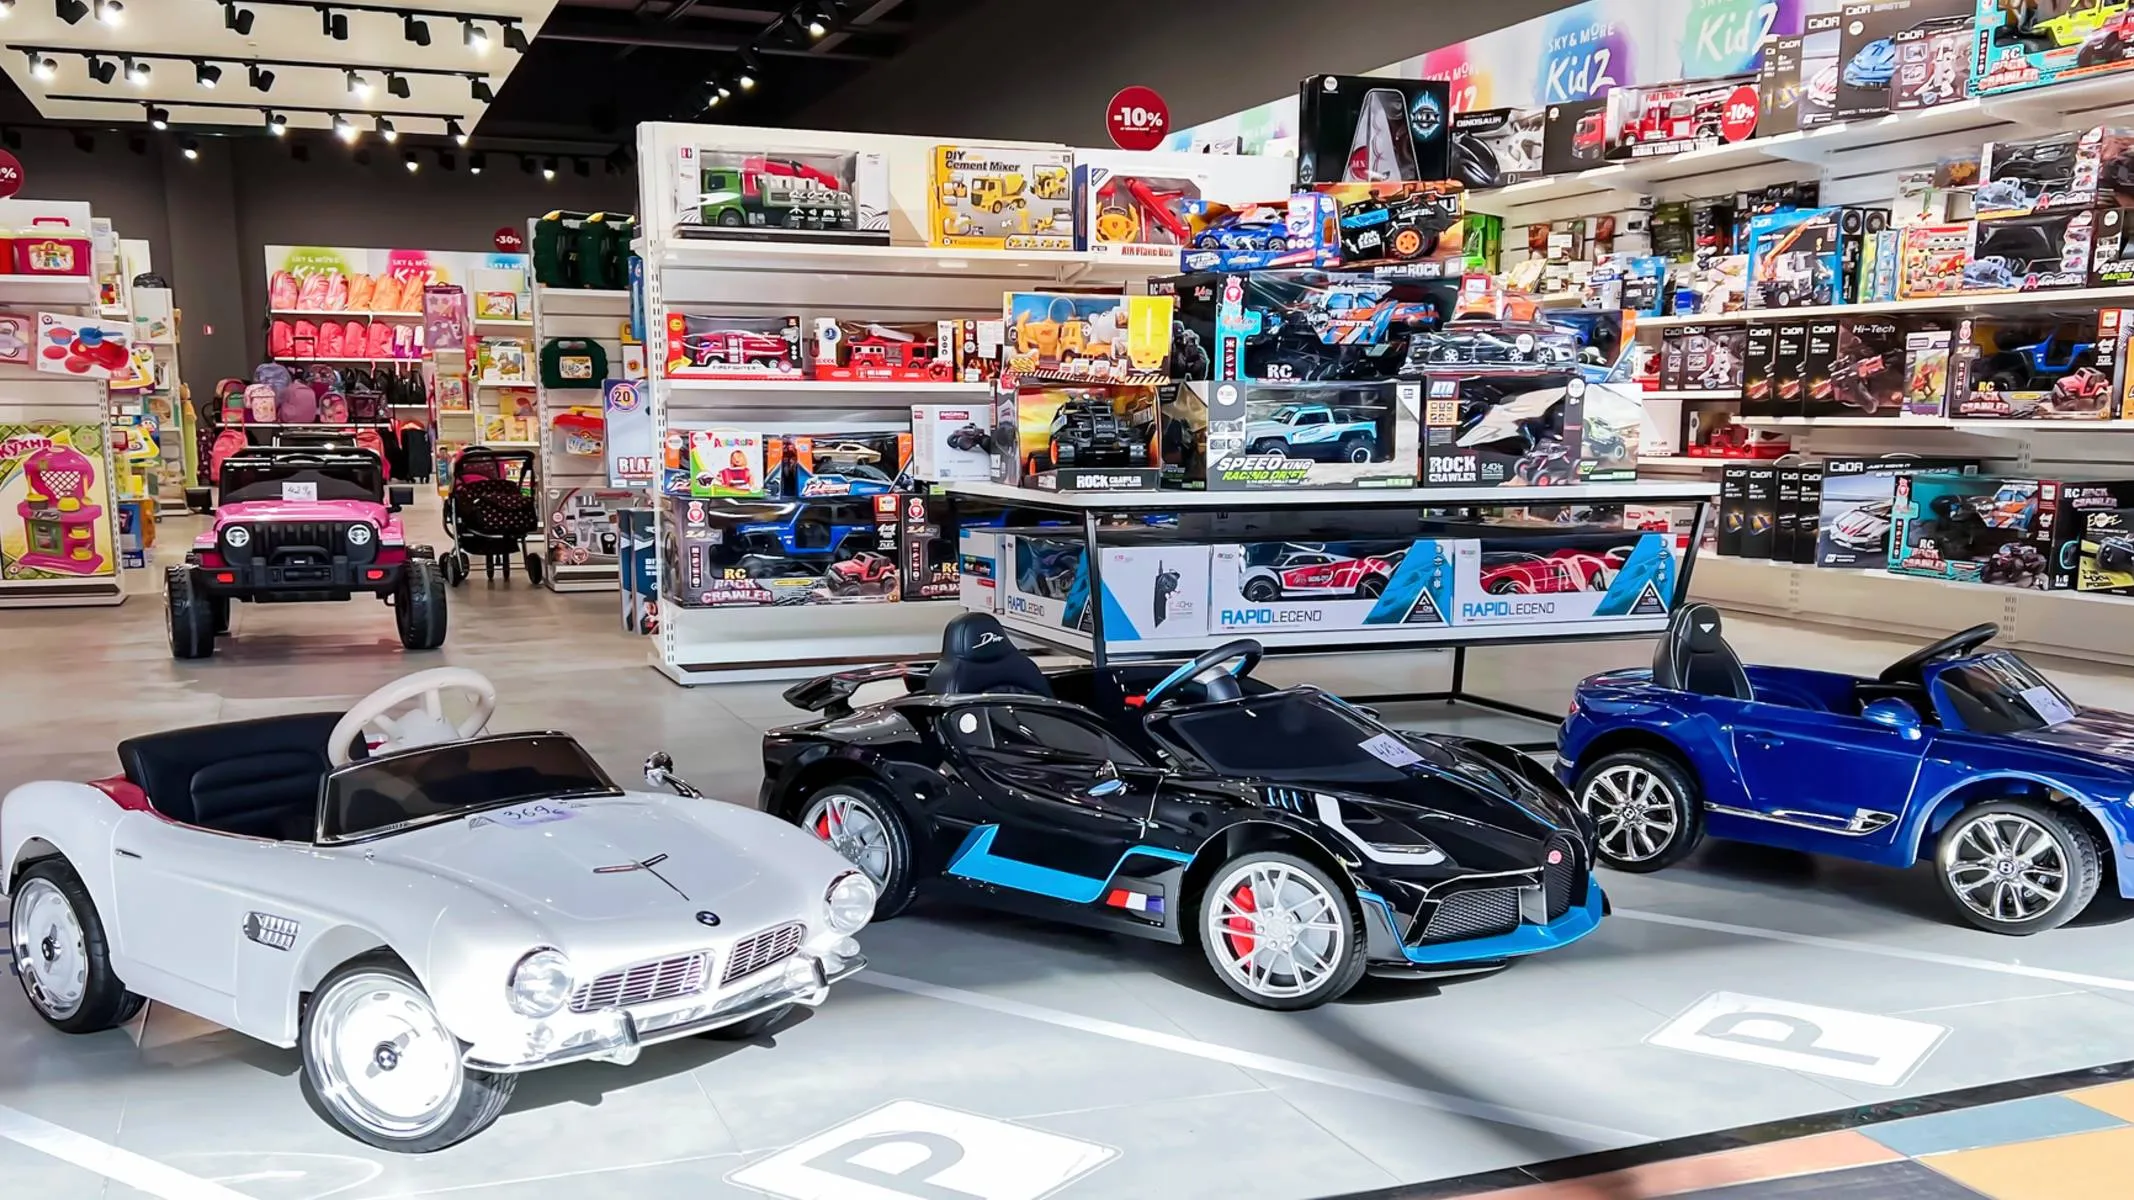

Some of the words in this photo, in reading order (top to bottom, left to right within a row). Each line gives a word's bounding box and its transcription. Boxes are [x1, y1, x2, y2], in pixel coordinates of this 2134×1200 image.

[1549, 36, 1569, 52] SKY
[1580, 24, 1615, 46] MORE
[1113, 107, 1163, 127] -10%
[1725, 103, 1755, 121] -10%
[1457, 116, 1502, 127] DINOSAUR
[945, 151, 966, 160] DIY
[946, 160, 987, 171] Cement
[990, 161, 1021, 172] Mixer
[496, 235, 521, 244] -30%
[1408, 264, 1441, 277] ROCK
[2098, 259, 2134, 274] SPEE
[1852, 325, 1896, 334] Hi-Tech
[1267, 363, 1293, 379] RC
[614, 391, 631, 403] 20
[1217, 456, 1283, 471] SPEED
[1428, 456, 1477, 472] ROCK
[1829, 461, 1864, 473] CaDA
[1076, 474, 1109, 488] ROCK
[1428, 472, 1477, 483] CRAWLER
[2064, 488, 2080, 498] RC
[1919, 538, 1935, 550] RC
[724, 568, 747, 580] RC
[701, 590, 774, 605] CRAWLER
[1463, 601, 1508, 617] RAPID
[1508, 602, 1556, 615] LEGEND
[1221, 609, 1271, 625] RAPID
[1271, 610, 1323, 623] LEGEND
[1694, 1012, 1881, 1066] P
